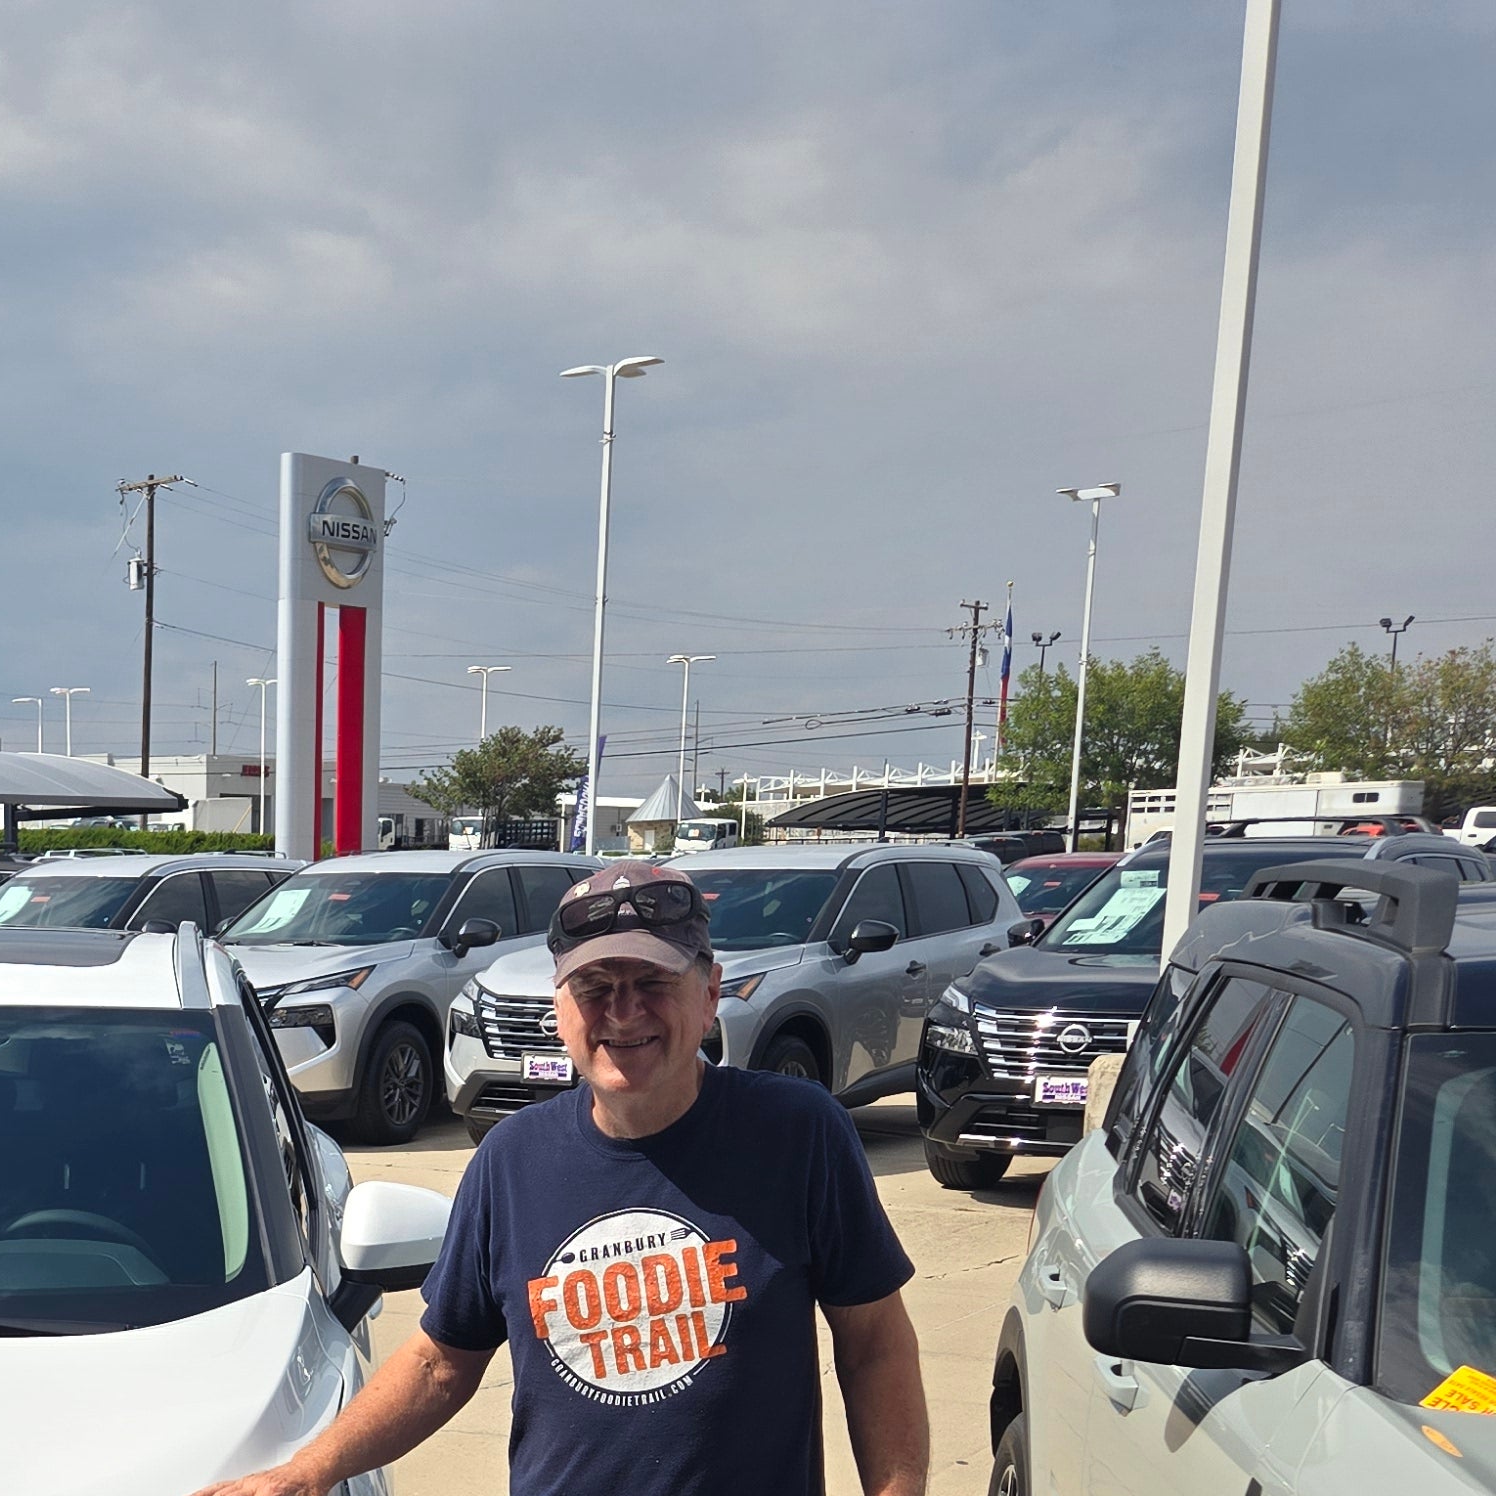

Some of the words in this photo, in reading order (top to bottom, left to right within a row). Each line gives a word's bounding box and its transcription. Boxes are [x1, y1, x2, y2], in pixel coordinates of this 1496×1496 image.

[322, 519, 377, 544] NISSAN
[579, 1232, 666, 1263] GRANBURY
[527, 1238, 748, 1340] FOODIE
[579, 1310, 728, 1380] TRAIL
[550, 1357, 694, 1407] GRANBURYFOODIETRAIL.COM
